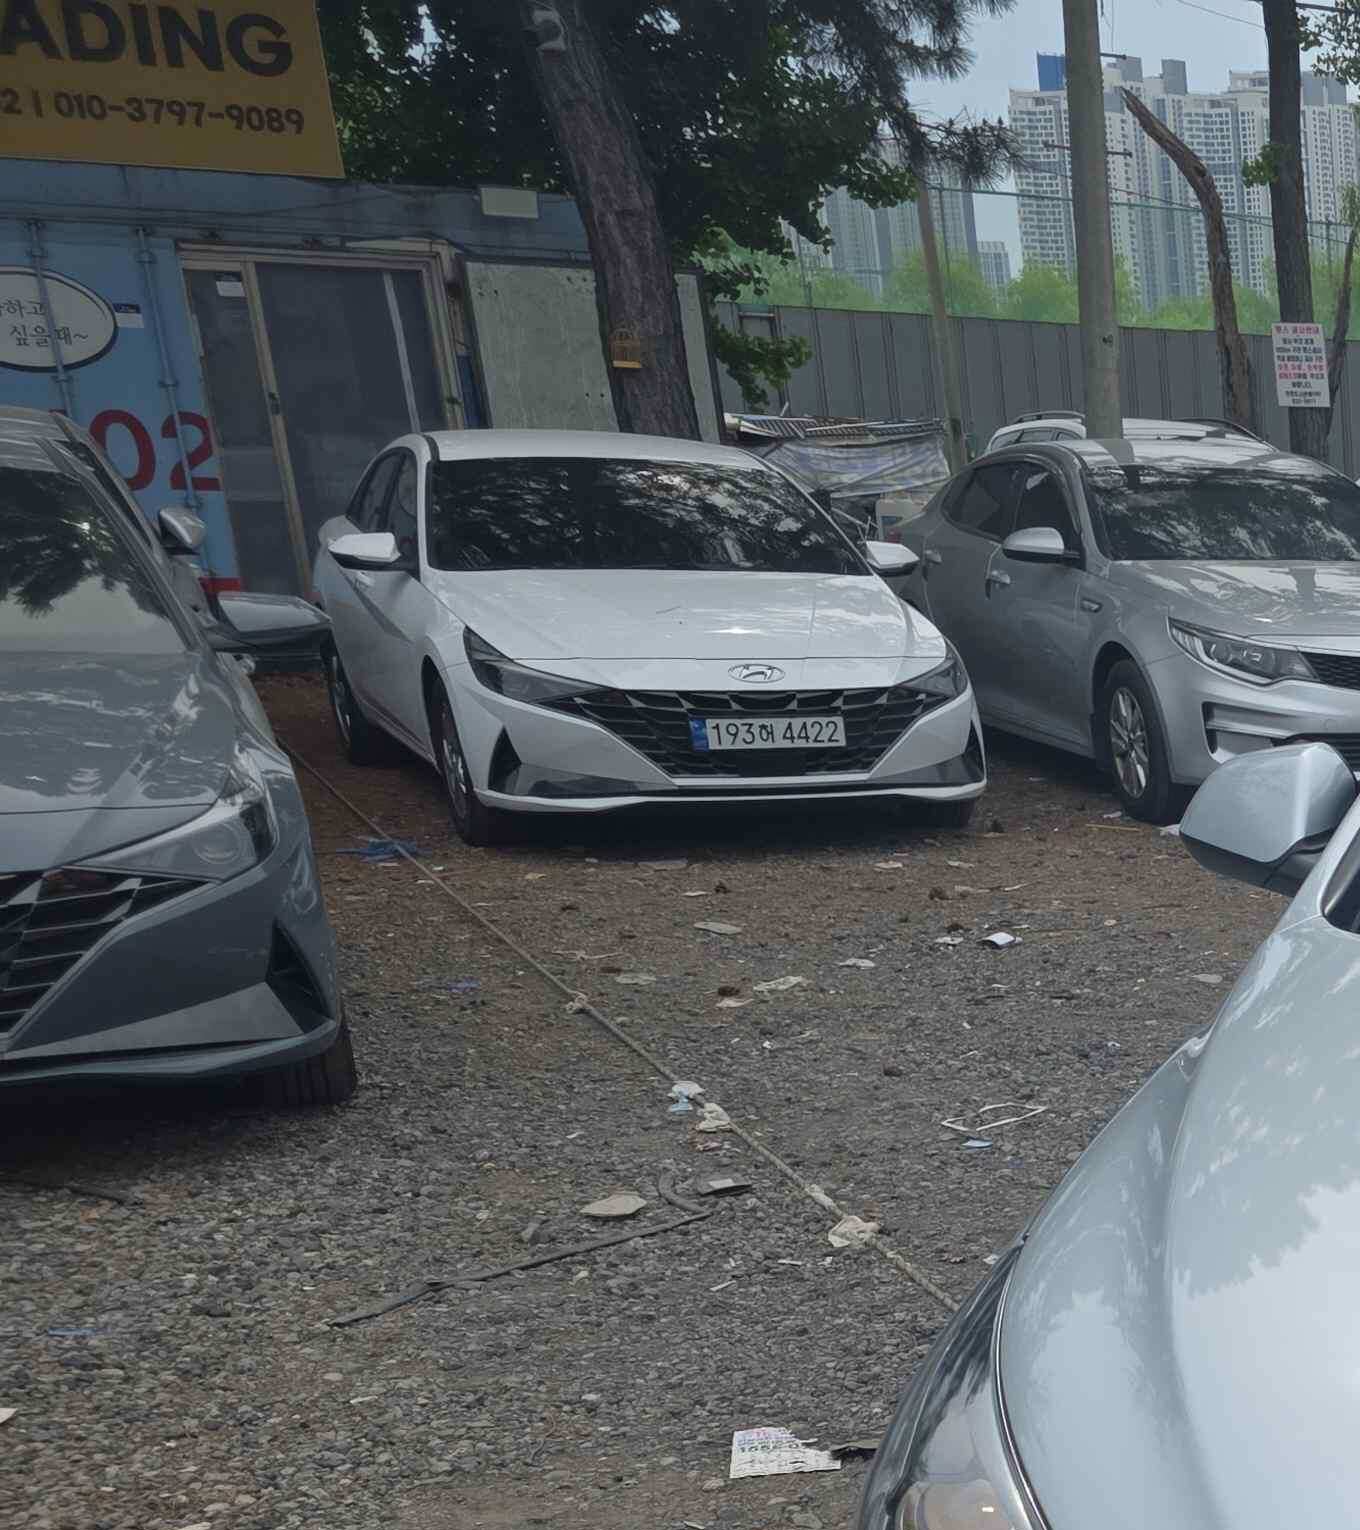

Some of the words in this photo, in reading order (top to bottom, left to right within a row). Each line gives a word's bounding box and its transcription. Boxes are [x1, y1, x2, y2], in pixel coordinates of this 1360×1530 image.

[54, 91, 305, 135] 010-3797-9089
[50, 409, 223, 491] 02
[711, 723, 776, 746] 193허
[782, 720, 841, 744] 4422
